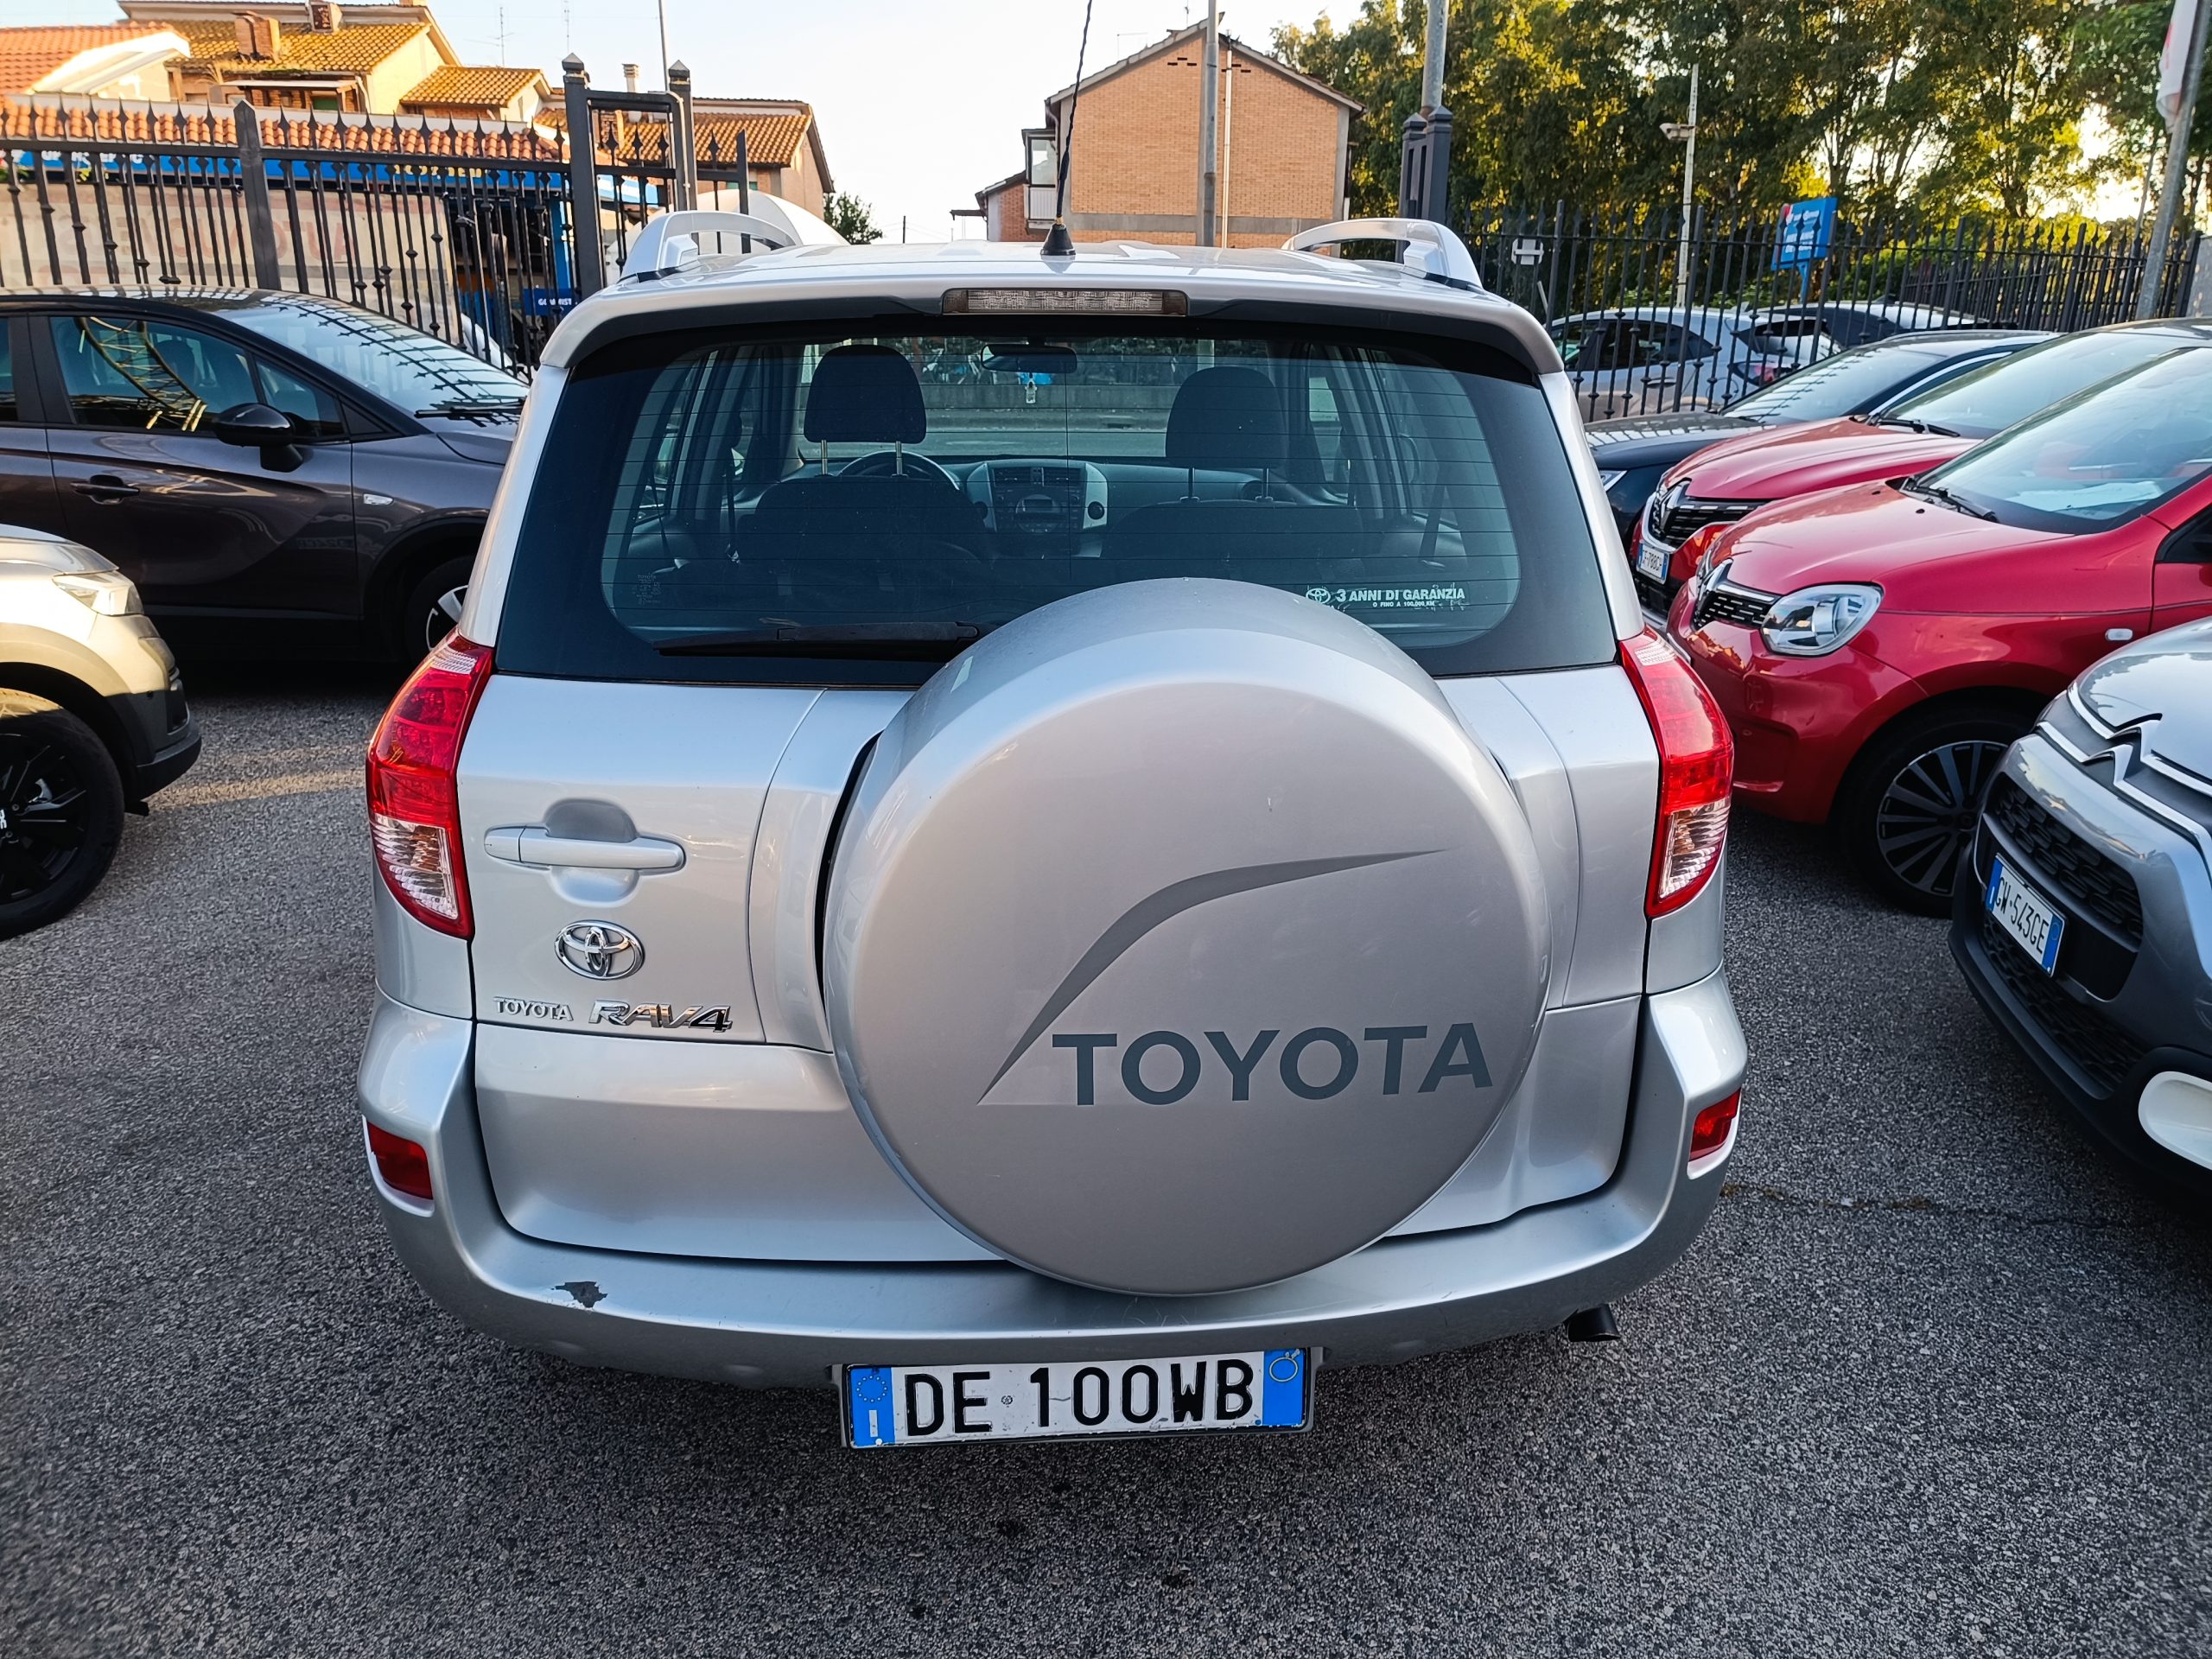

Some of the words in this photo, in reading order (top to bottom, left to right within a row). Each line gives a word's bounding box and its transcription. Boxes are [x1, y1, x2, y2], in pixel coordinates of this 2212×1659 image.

[1336, 588, 1346, 601] 3
[1349, 589, 1382, 601] ANNI
[1386, 588, 1399, 601] DI
[1402, 588, 1465, 600] GARANZIA
[2010, 893, 2050, 954] 543GE
[493, 996, 574, 1022] TOYOTA
[588, 1000, 734, 1033] RAV4
[1052, 1022, 1494, 1106] TOYOTA
[905, 1370, 994, 1436] DE
[1029, 1358, 1255, 1427] 100WB
